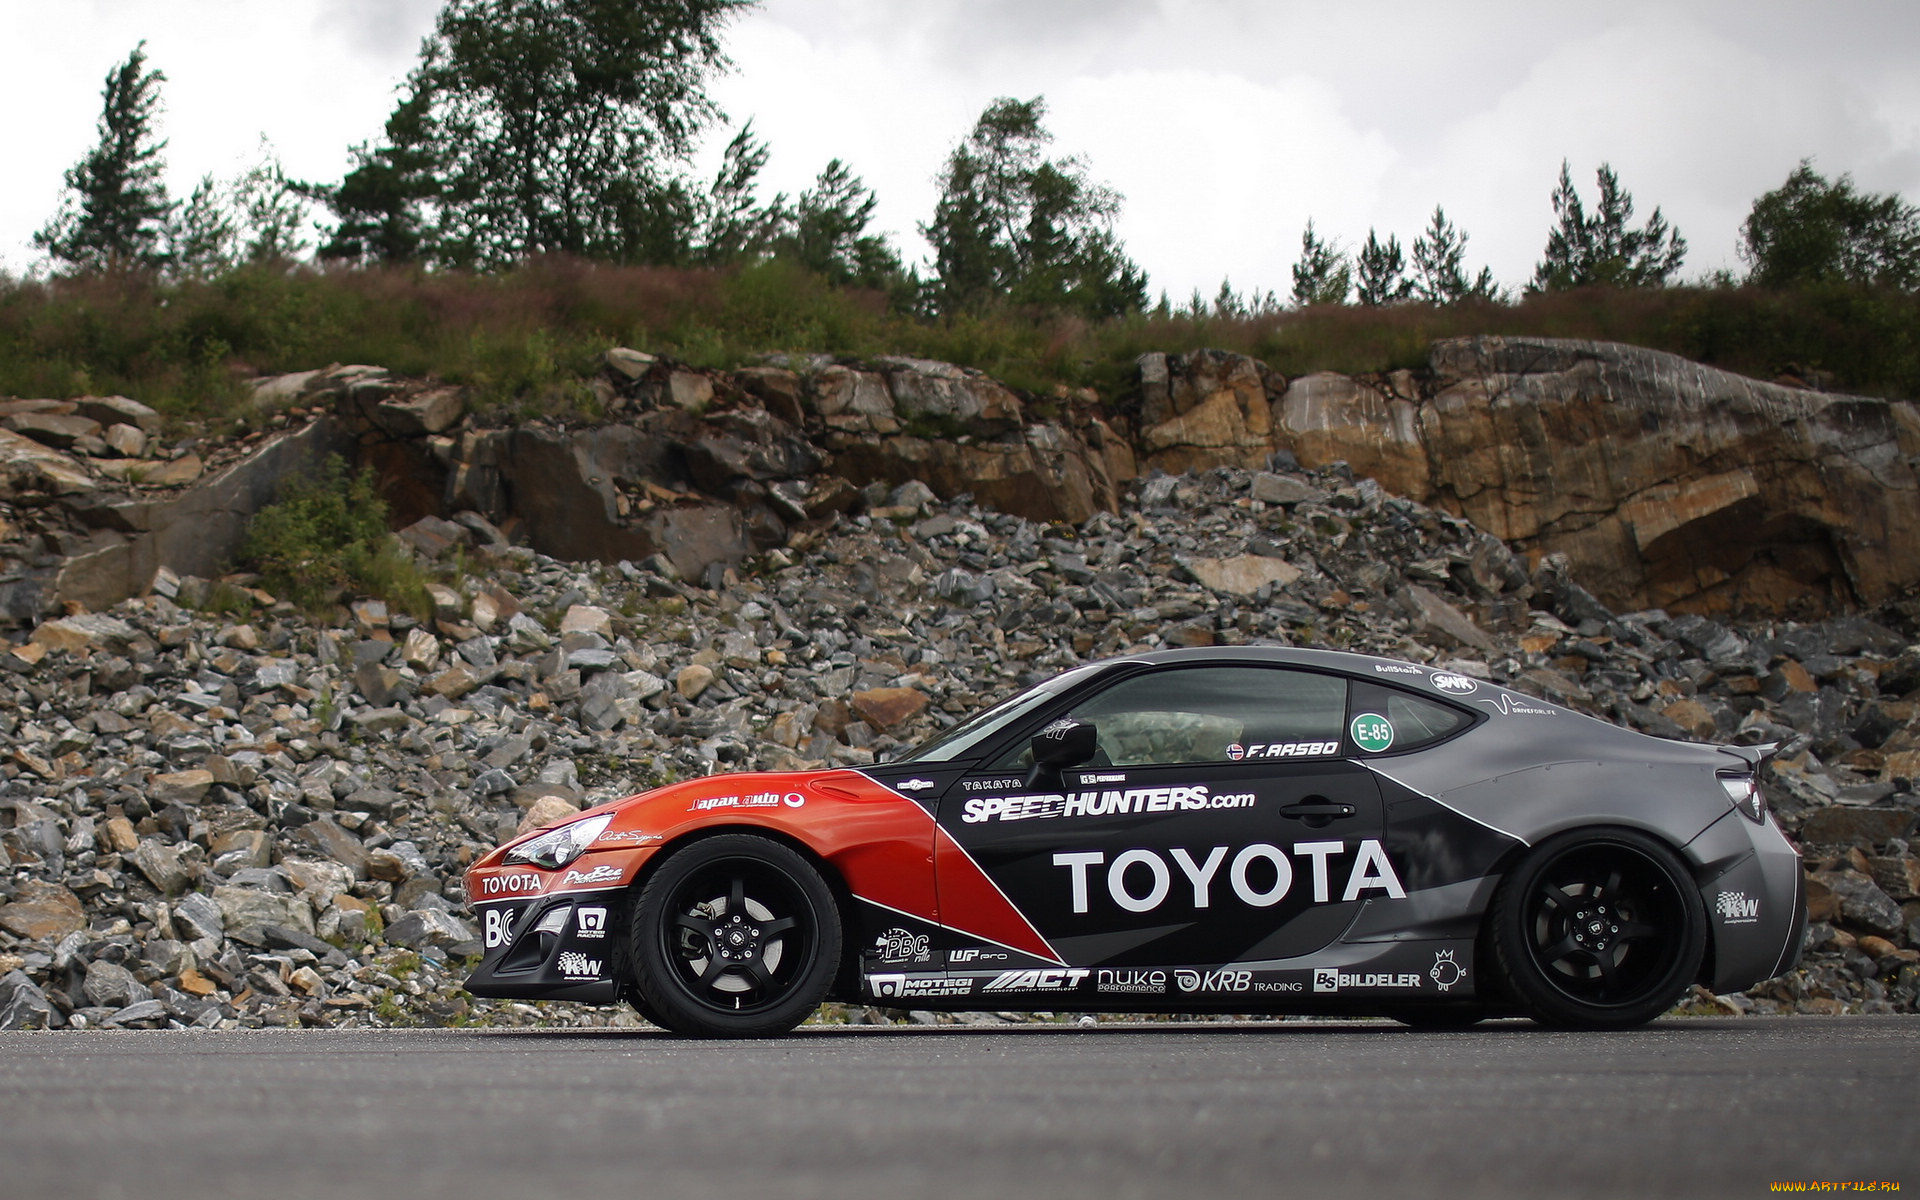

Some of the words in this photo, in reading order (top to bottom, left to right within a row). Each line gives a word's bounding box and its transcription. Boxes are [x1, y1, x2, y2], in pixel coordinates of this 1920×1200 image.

[1357, 723, 1389, 741] E-85
[963, 779, 1021, 790] TAKATA
[482, 874, 542, 894] TOYOTA
[1053, 839, 1407, 913] TOYOTA
[885, 935, 929, 958] PBC
[905, 978, 973, 988] MOTEGI
[1201, 970, 1252, 991] KRB
[1254, 982, 1303, 991] TRADING
[1339, 974, 1421, 987] BILDELER
[903, 987, 971, 997] RACING
